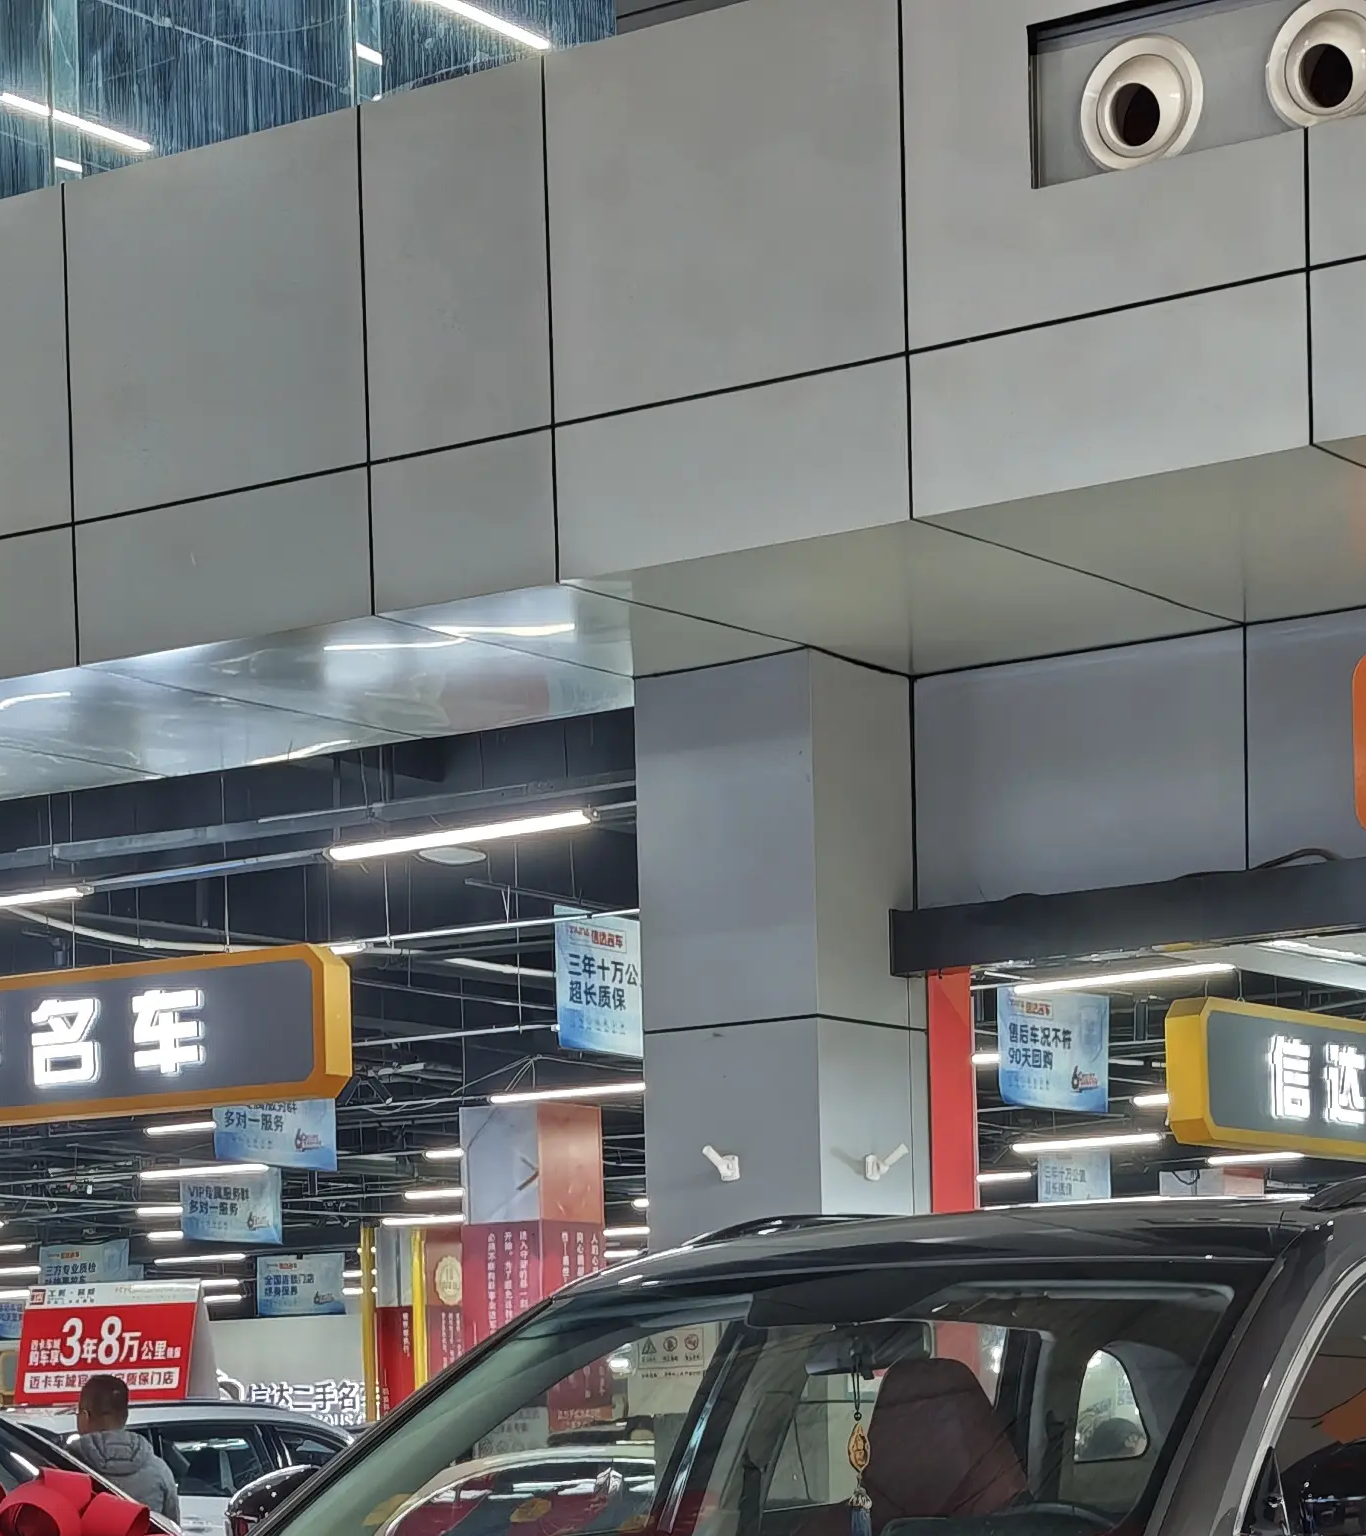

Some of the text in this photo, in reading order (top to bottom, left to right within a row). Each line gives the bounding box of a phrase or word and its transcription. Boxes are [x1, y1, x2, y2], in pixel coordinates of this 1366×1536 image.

[568, 979, 627, 1011] 超长质保
[1008, 1022, 1073, 1050] 售后车况不符
[1008, 1048, 1054, 1071] 90天回购
[224, 1111, 285, 1132] 多对一服务
[189, 1201, 239, 1216] 多对一服务
[45, 1262, 97, 1275] 三方专业质检
[59, 1314, 182, 1367] 3年8万公里
[29, 1370, 174, 1390] 迈卡车城官质保门店
